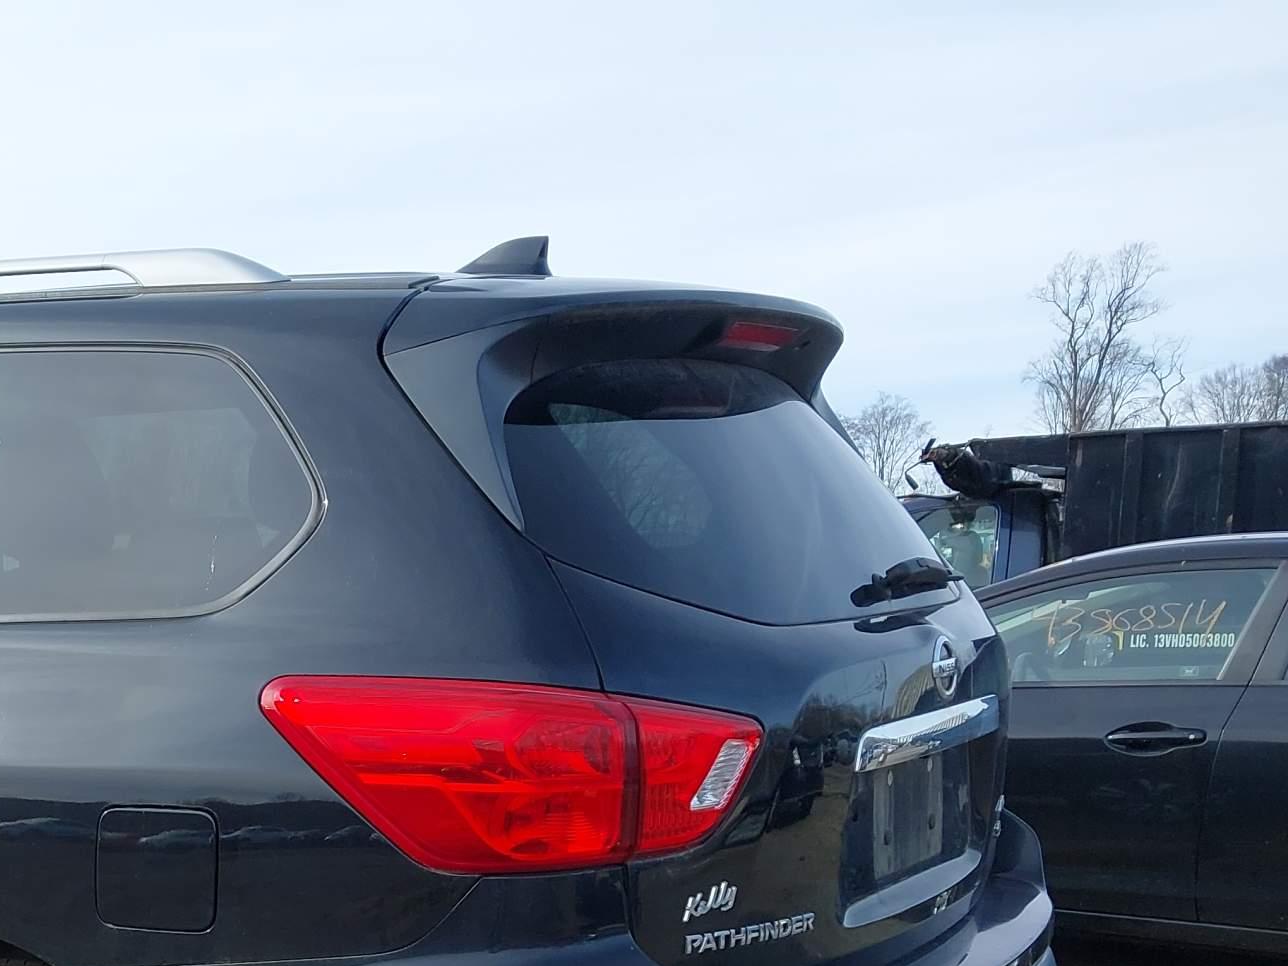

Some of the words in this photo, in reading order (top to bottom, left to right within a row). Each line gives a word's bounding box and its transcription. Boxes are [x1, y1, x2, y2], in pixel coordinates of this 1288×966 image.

[1130, 634, 1149, 648] LIC.
[682, 880, 738, 923] Kelly
[684, 912, 815, 955] PATHFINDER
